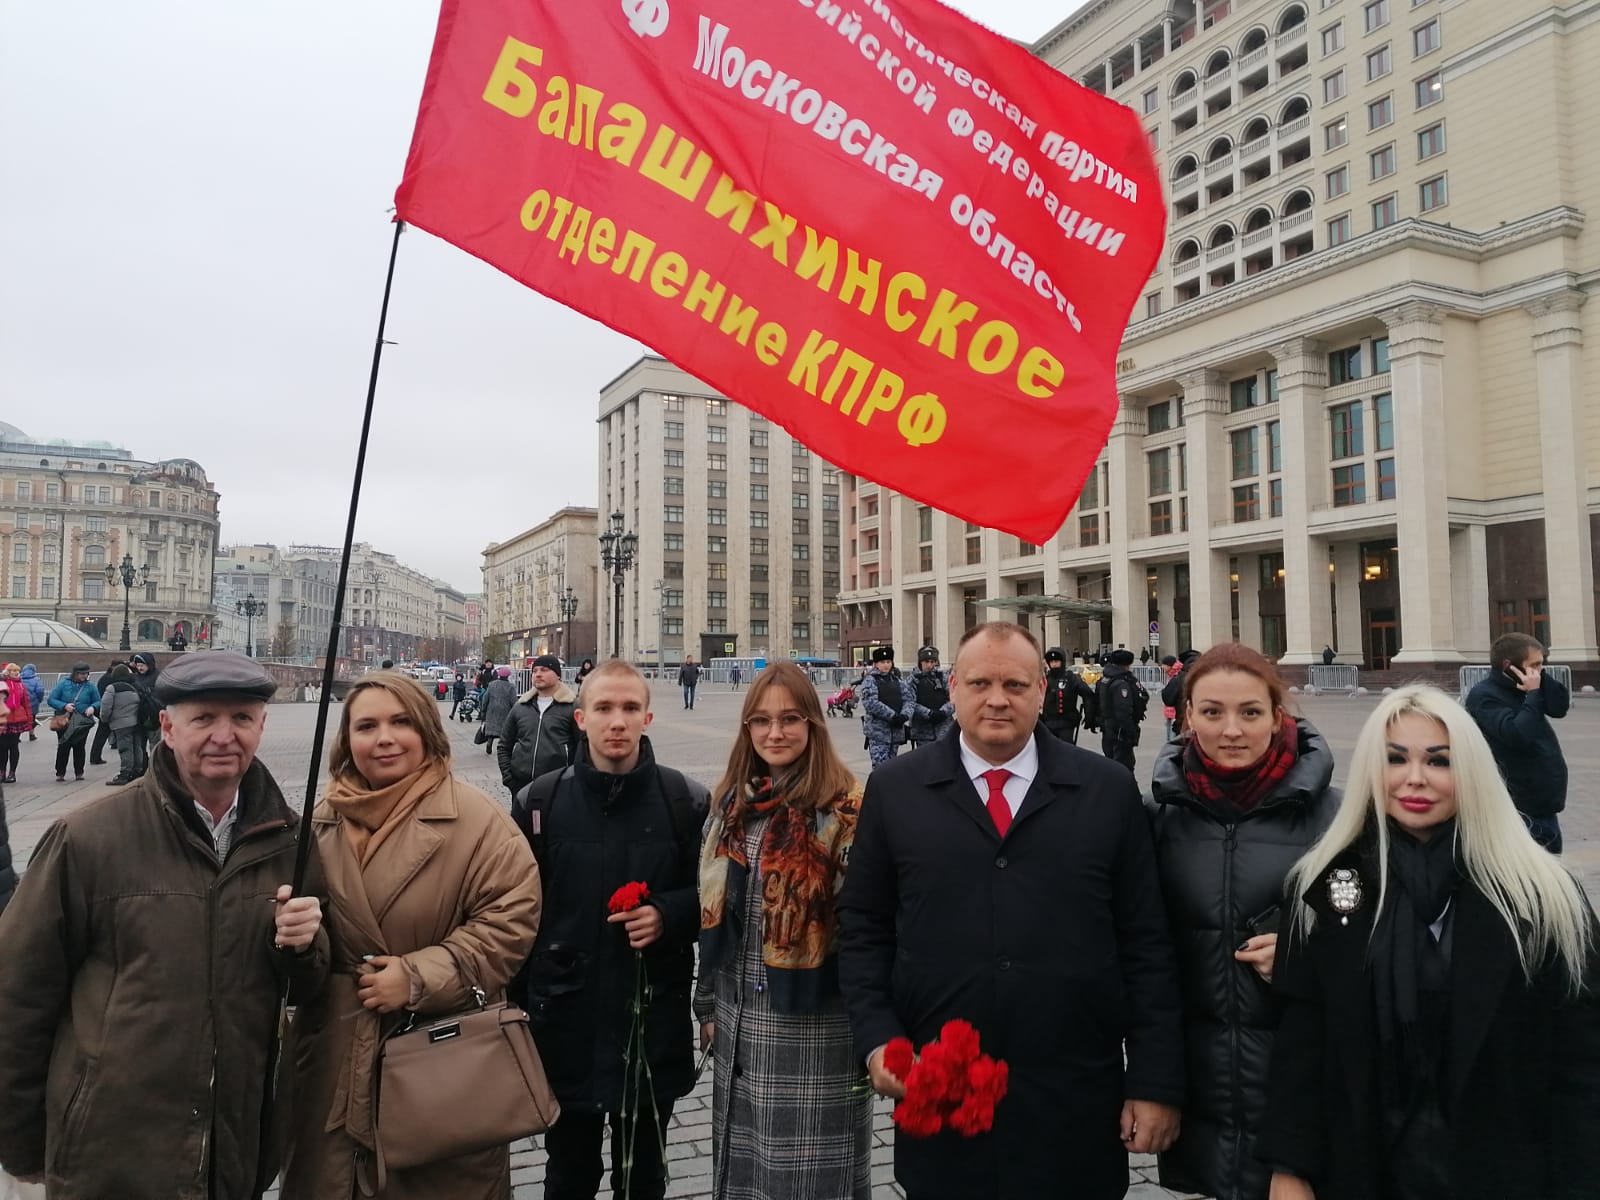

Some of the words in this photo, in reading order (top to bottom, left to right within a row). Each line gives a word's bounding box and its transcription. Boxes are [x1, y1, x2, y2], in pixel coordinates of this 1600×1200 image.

[482, 35, 1066, 399] Балашихинское
[692, 14, 944, 201] Московская
[950, 194, 1082, 332] область
[947, 107, 1126, 256] Федерации
[1039, 131, 1137, 203] партия
[520, 189, 788, 367] отделение
[787, 329, 948, 447] КПРФ
